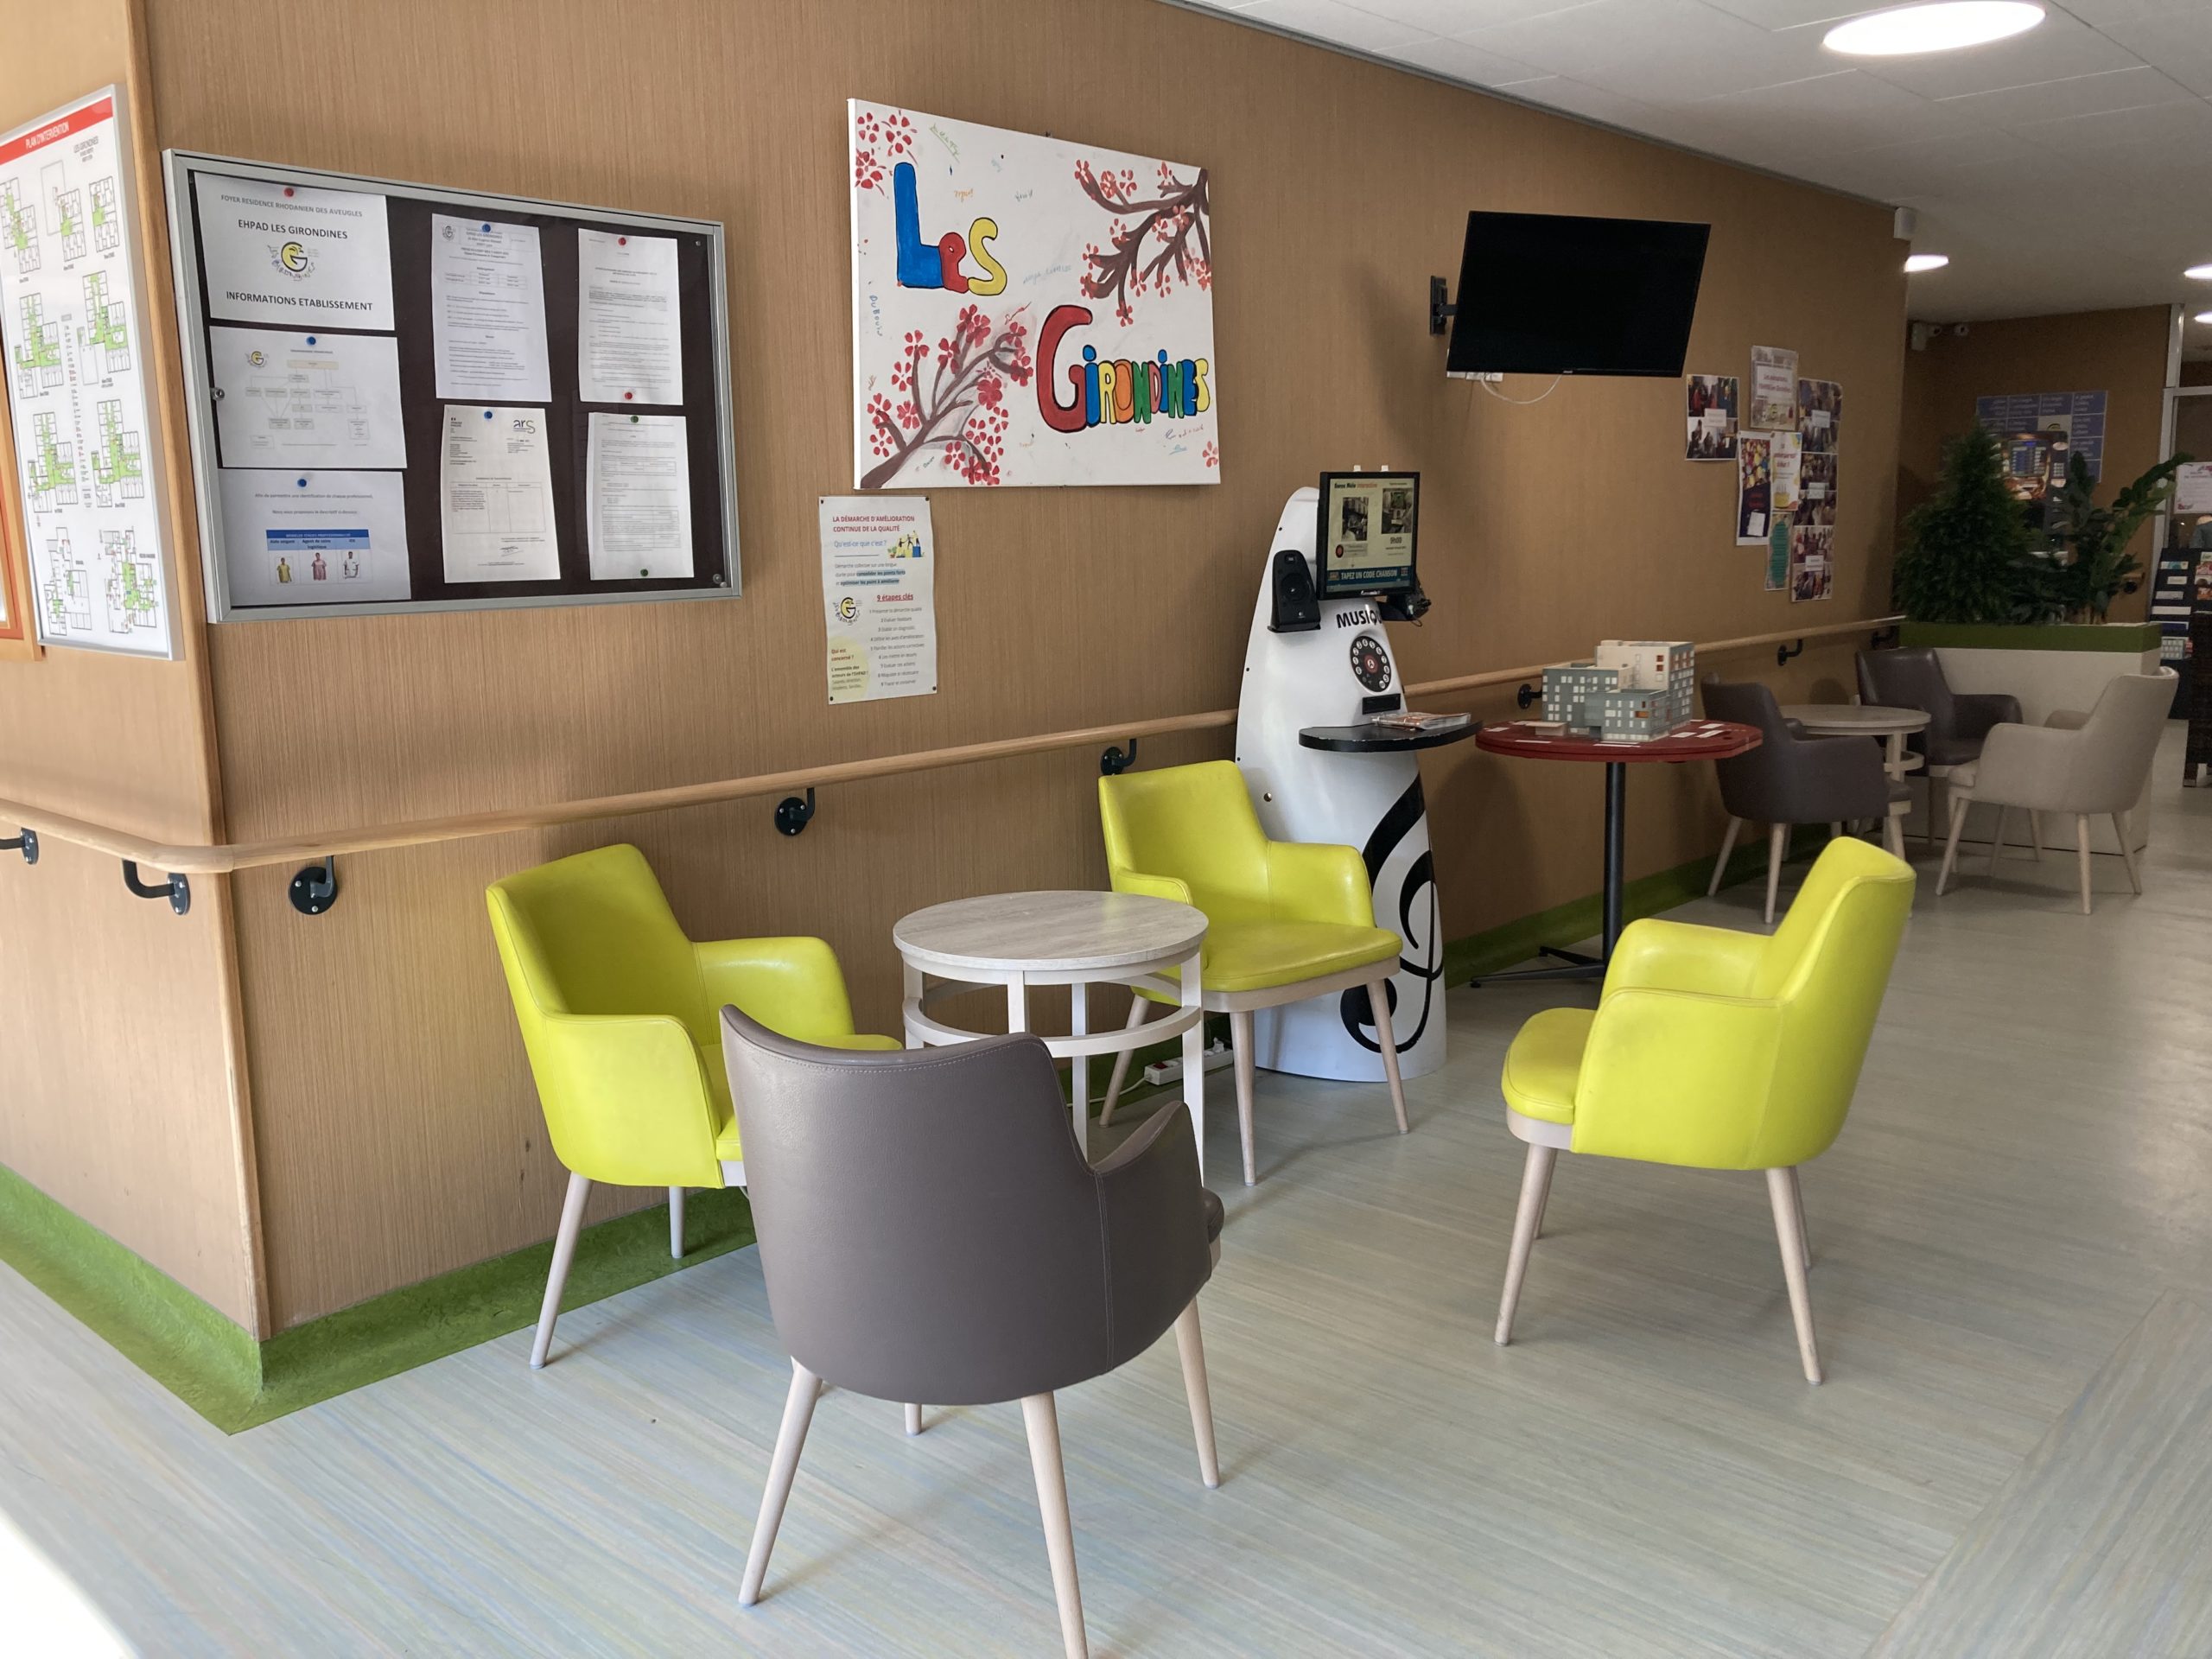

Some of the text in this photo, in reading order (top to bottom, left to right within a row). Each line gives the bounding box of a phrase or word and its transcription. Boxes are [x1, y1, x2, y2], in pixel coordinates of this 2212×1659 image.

[221, 194, 240, 203] FOYER
[242, 197, 275, 208] RESIDENCE
[275, 202, 315, 213] RHODANIEN
[329, 208, 362, 217] AVEUGLES
[238, 219, 348, 239] EHPAD LES GIRONDINES
[226, 291, 372, 311] INFORMATIONS ETABLISSEMENT
